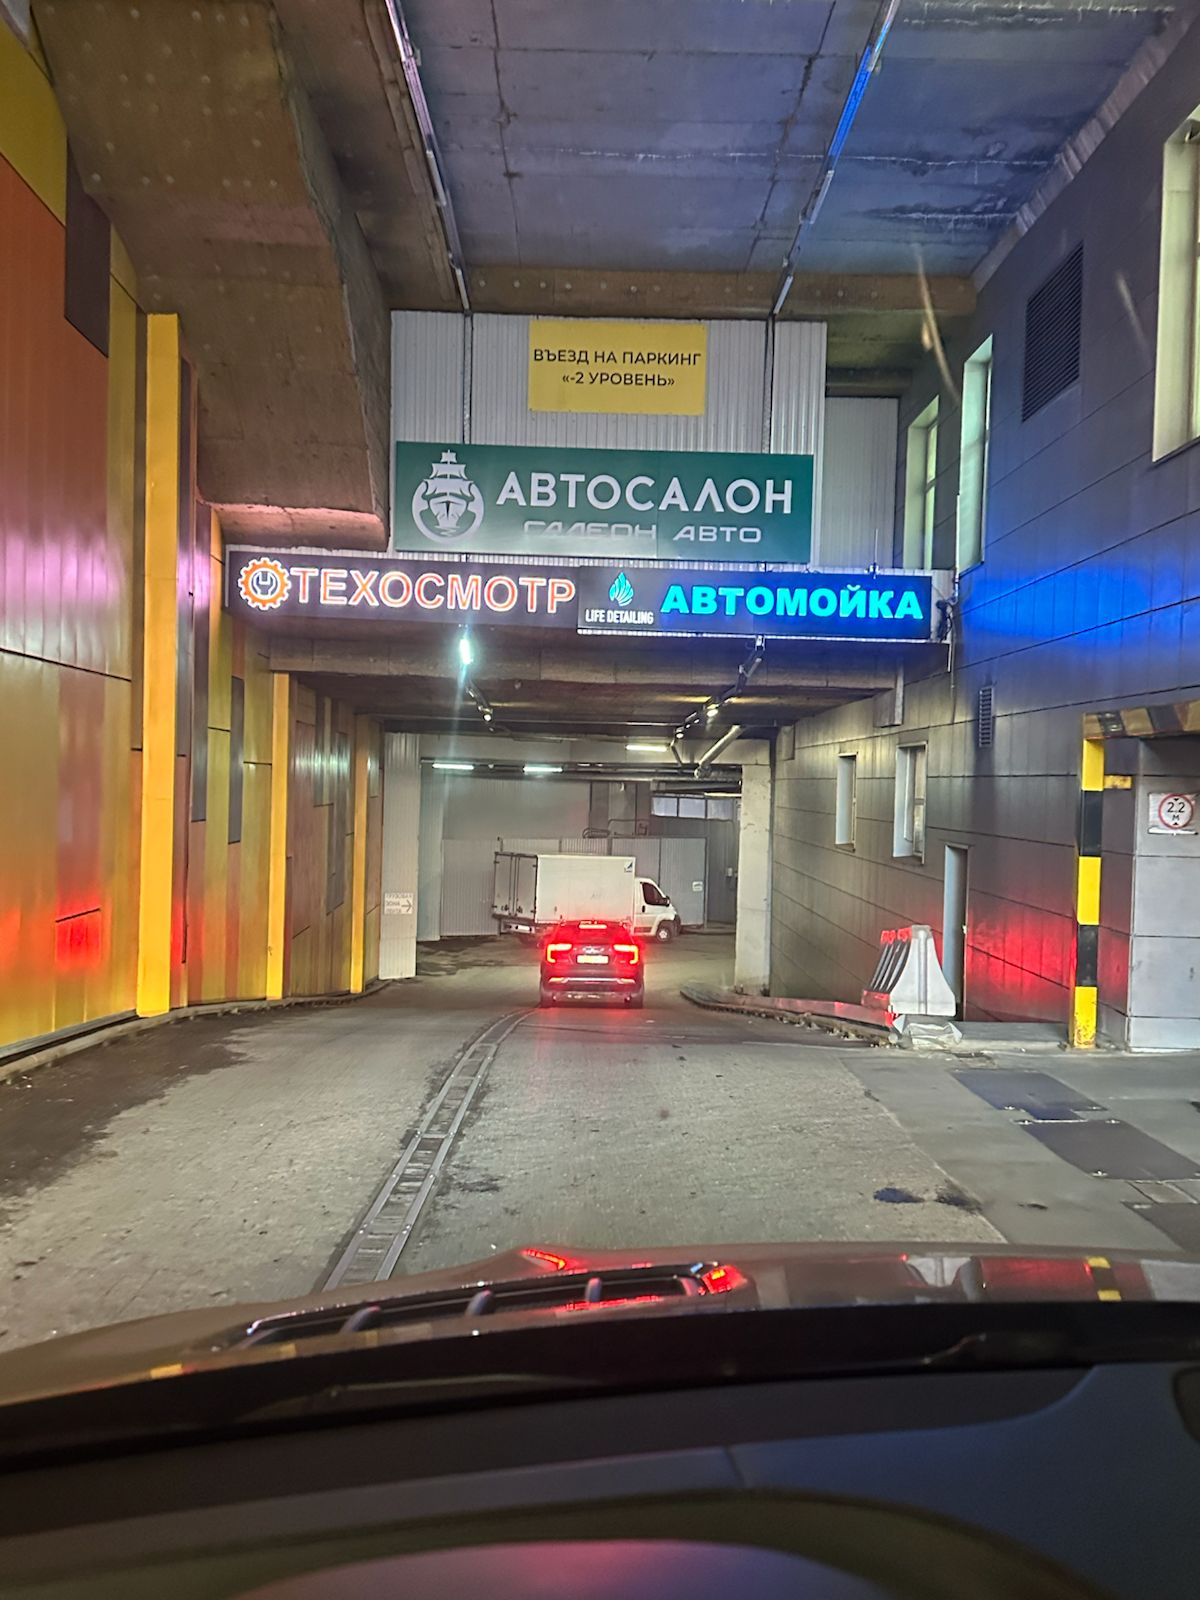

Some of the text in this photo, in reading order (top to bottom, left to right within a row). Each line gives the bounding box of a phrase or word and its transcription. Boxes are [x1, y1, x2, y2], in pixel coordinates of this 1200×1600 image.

[533, 348, 702, 366] ВЪЕЗД НА ПАРКИНГ
[562, 372, 675, 387] «-2 УРОВЕНЬ»
[496, 470, 793, 515] АВТОСАЛОН
[672, 525, 762, 543] АВТО
[290, 567, 577, 613] ТЕХОСМОТР
[660, 584, 924, 620] АВТОМОЙКА
[585, 609, 654, 625] LIFE DETAILING
